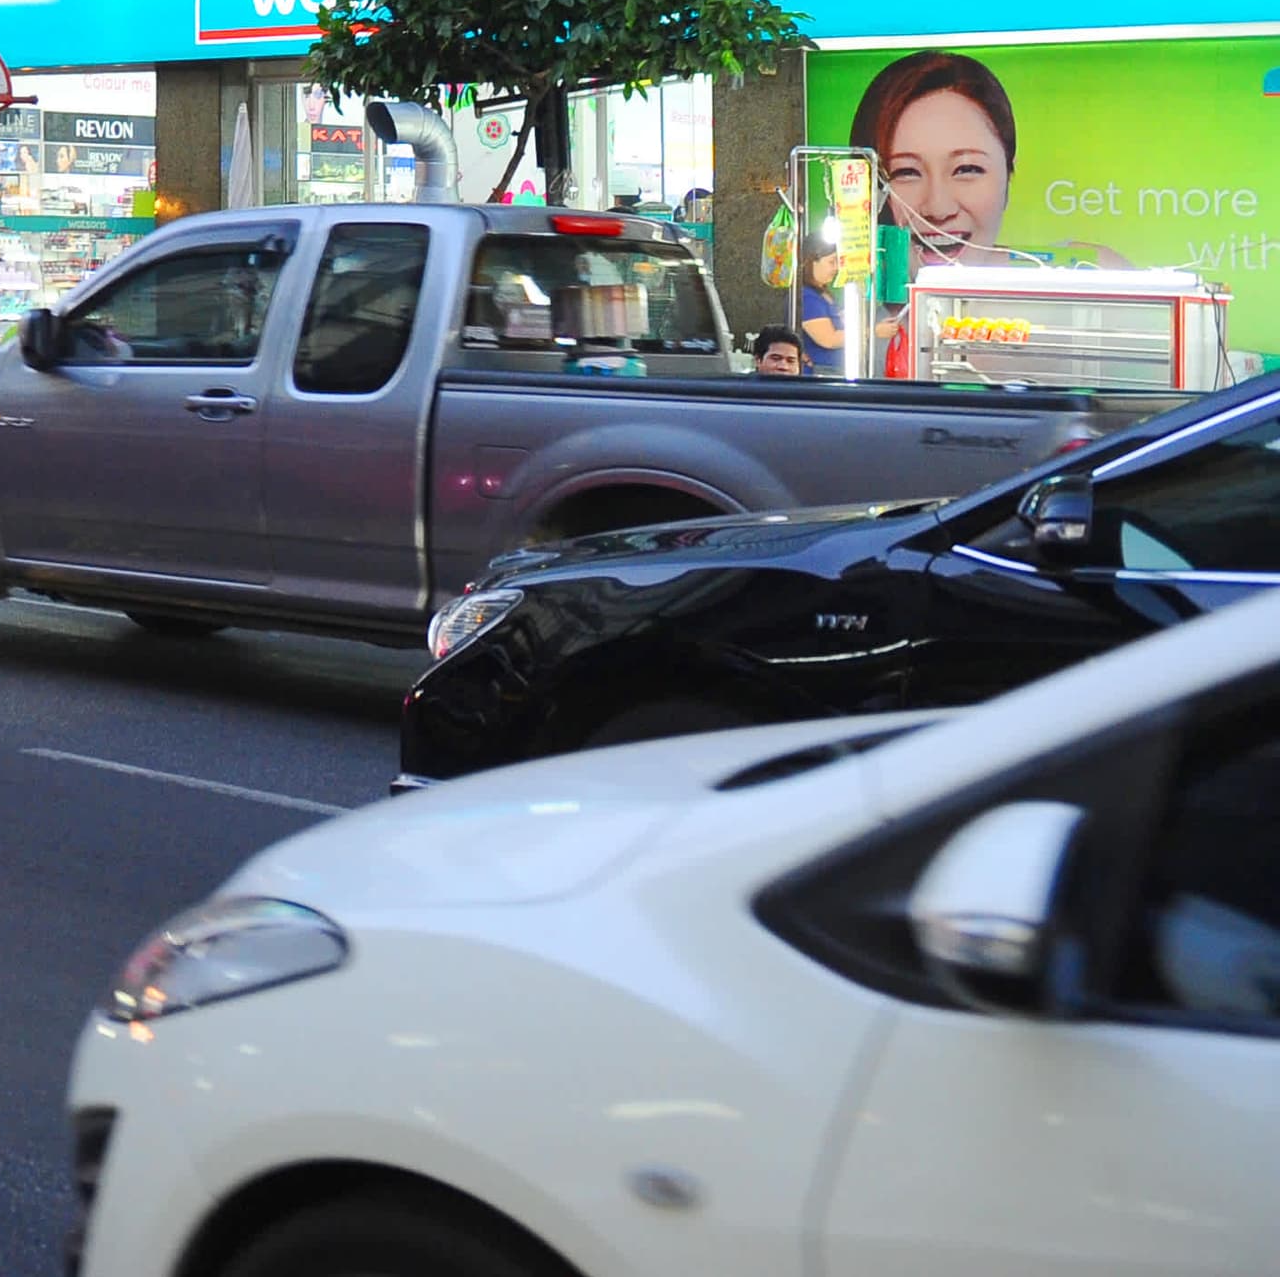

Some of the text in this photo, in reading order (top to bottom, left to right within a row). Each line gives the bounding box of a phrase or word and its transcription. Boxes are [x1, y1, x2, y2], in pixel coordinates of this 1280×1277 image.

[74, 118, 135, 140] REVLON
[1044, 179, 1259, 217] Get more
